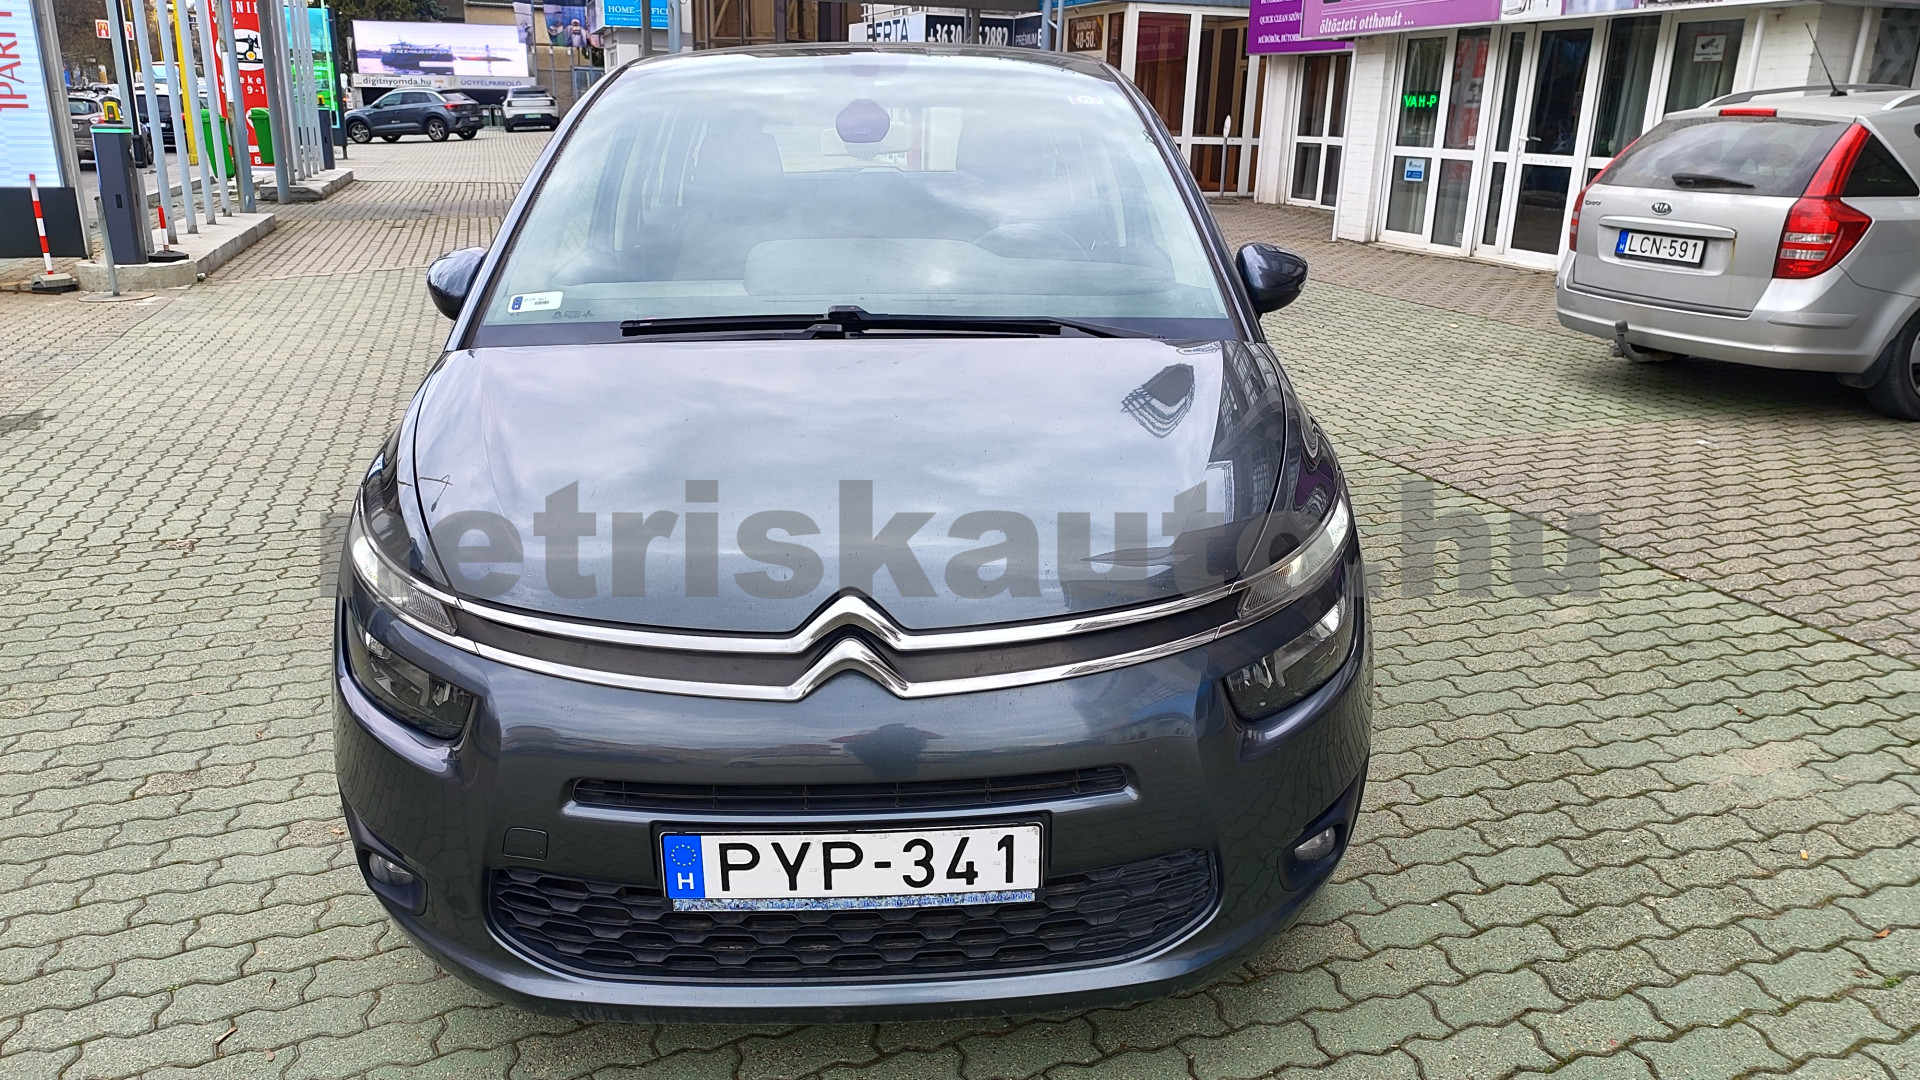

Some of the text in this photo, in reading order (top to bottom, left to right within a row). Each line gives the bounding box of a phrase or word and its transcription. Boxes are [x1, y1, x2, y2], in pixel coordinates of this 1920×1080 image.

[1320, 15, 1358, 34] öltözteti
[1359, 9, 1403, 30] otthonát
[1015, 32, 1037, 46] PRÉMIUM
[362, 77, 432, 86] digitnyomda.hu
[1628, 235, 1698, 259] LCN-591
[718, 834, 1015, 892] PYP-341
[677, 872, 695, 890] H
